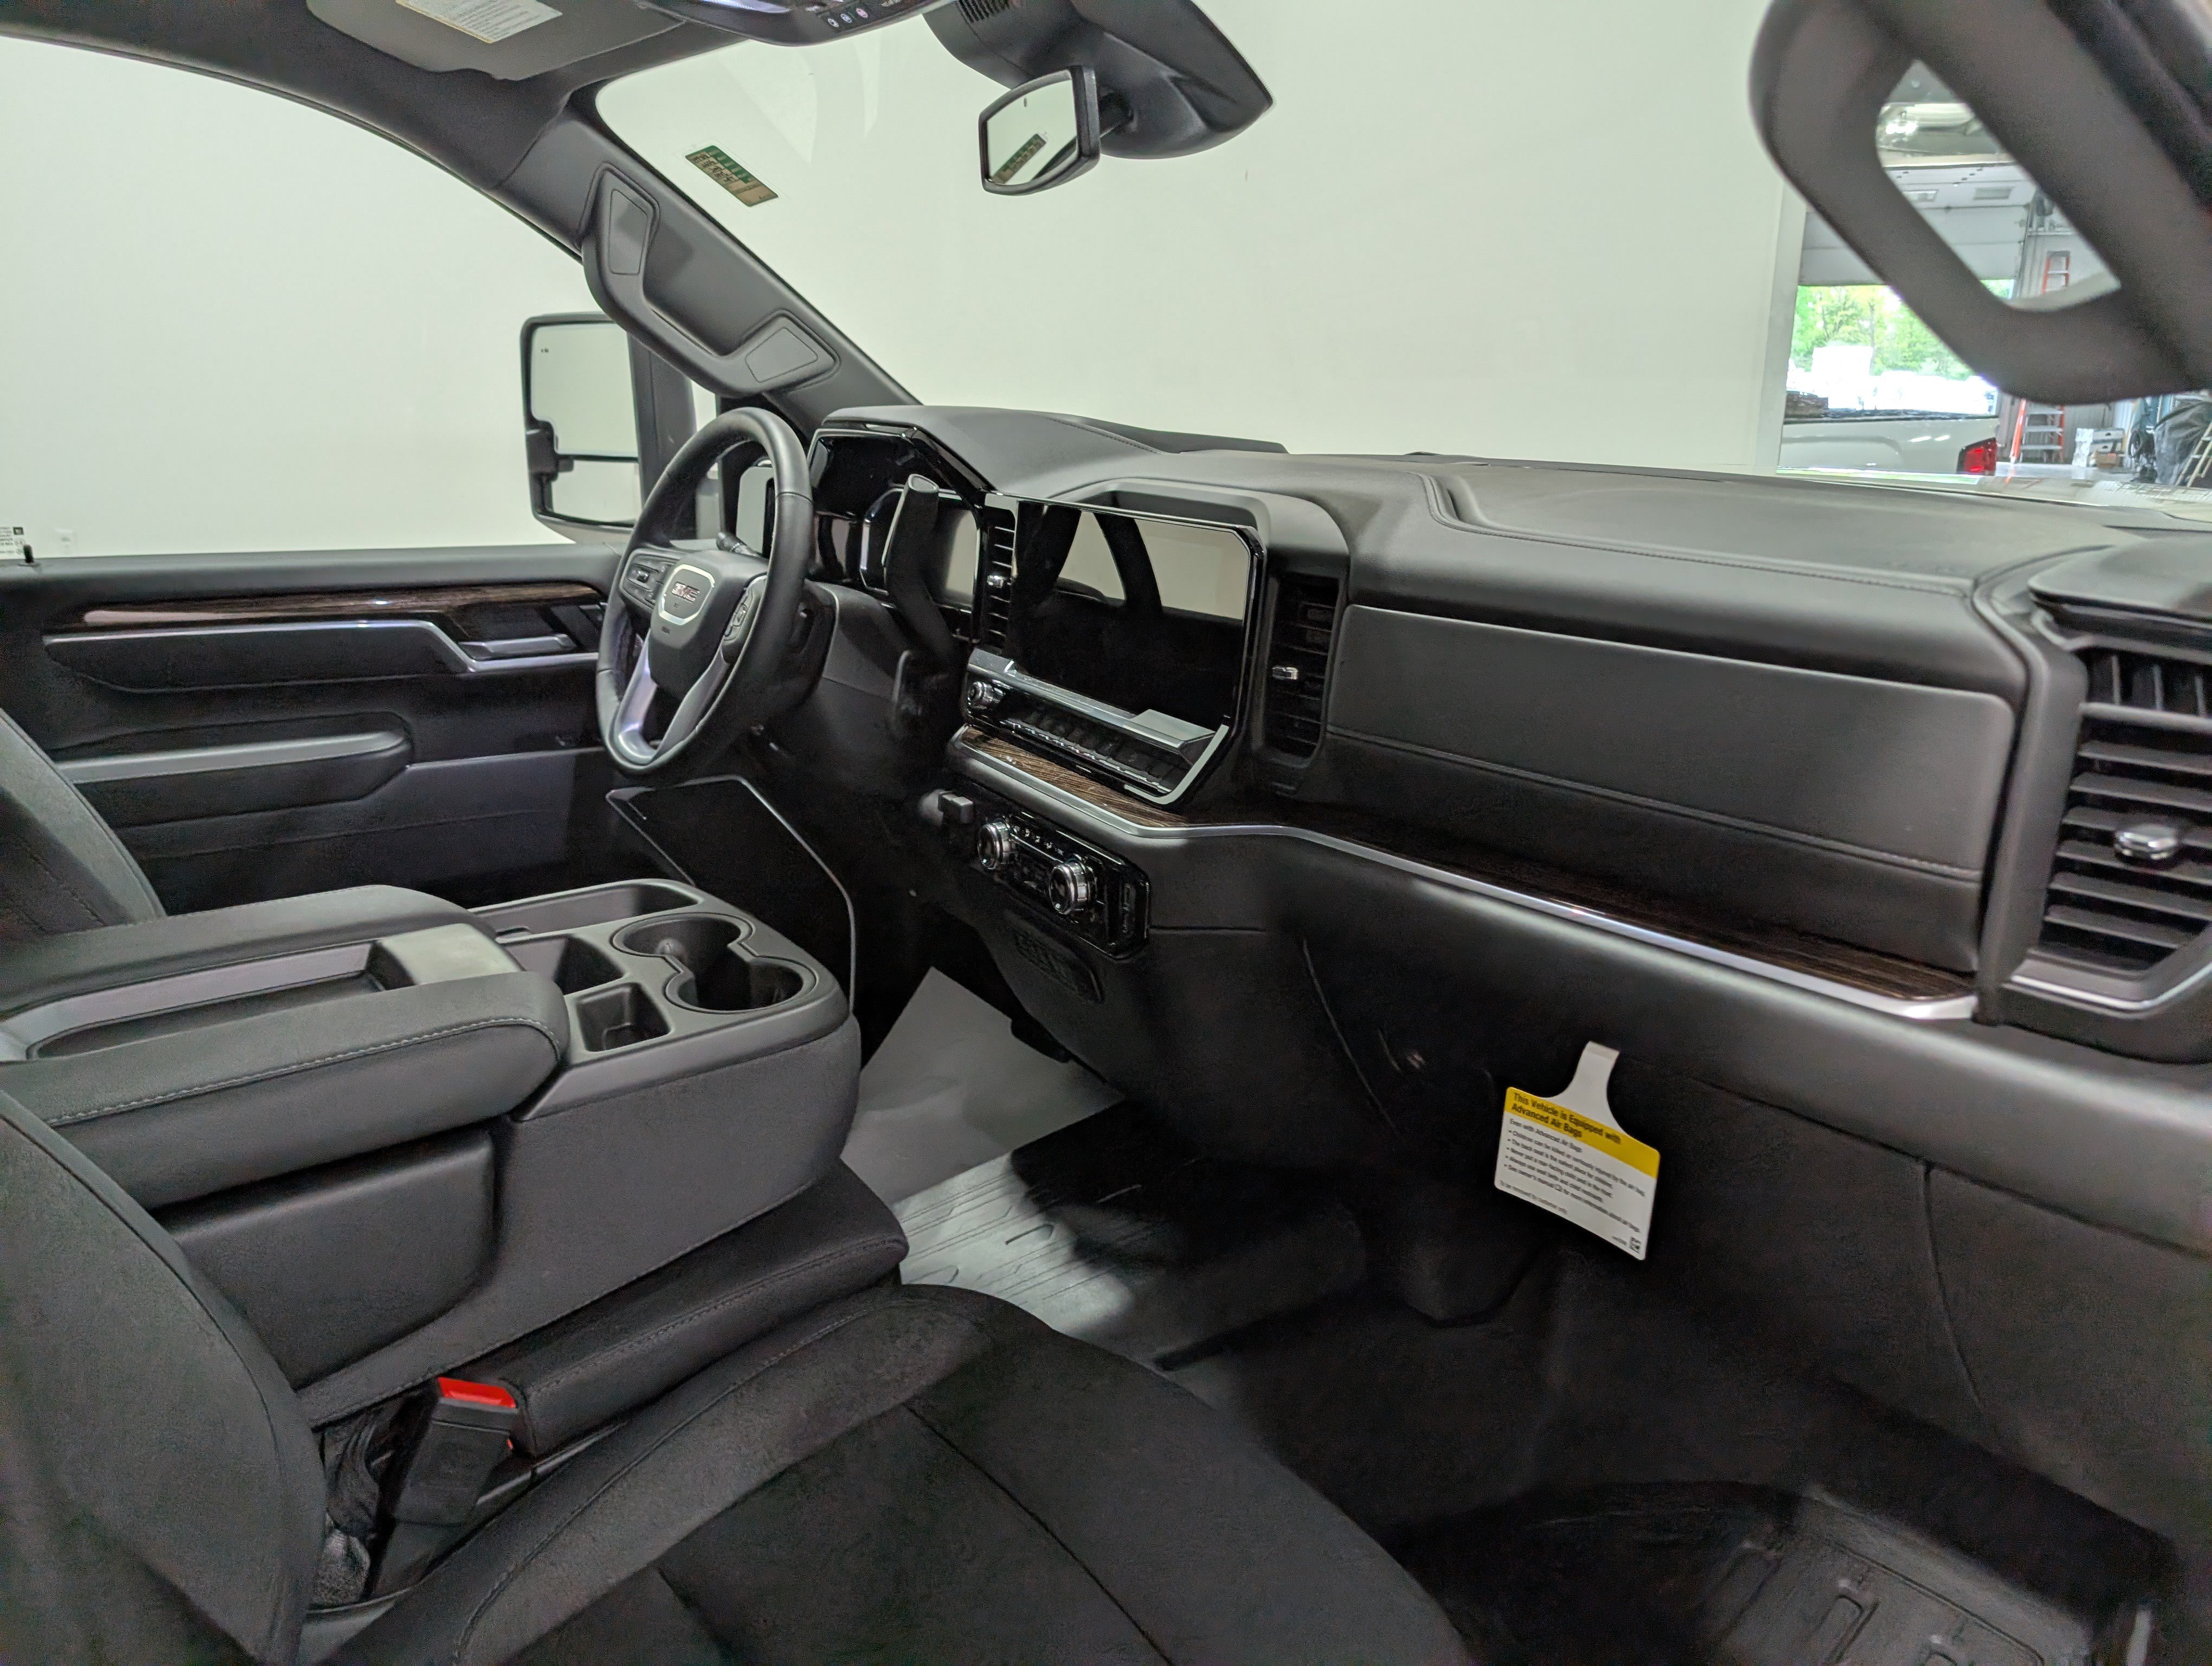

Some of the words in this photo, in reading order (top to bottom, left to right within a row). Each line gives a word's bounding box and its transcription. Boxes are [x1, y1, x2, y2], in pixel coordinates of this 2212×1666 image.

[1511, 1103, 1549, 1124] Advanced
[1514, 1092, 1529, 1105] This
[1531, 1099, 1558, 1117] Vehicle
